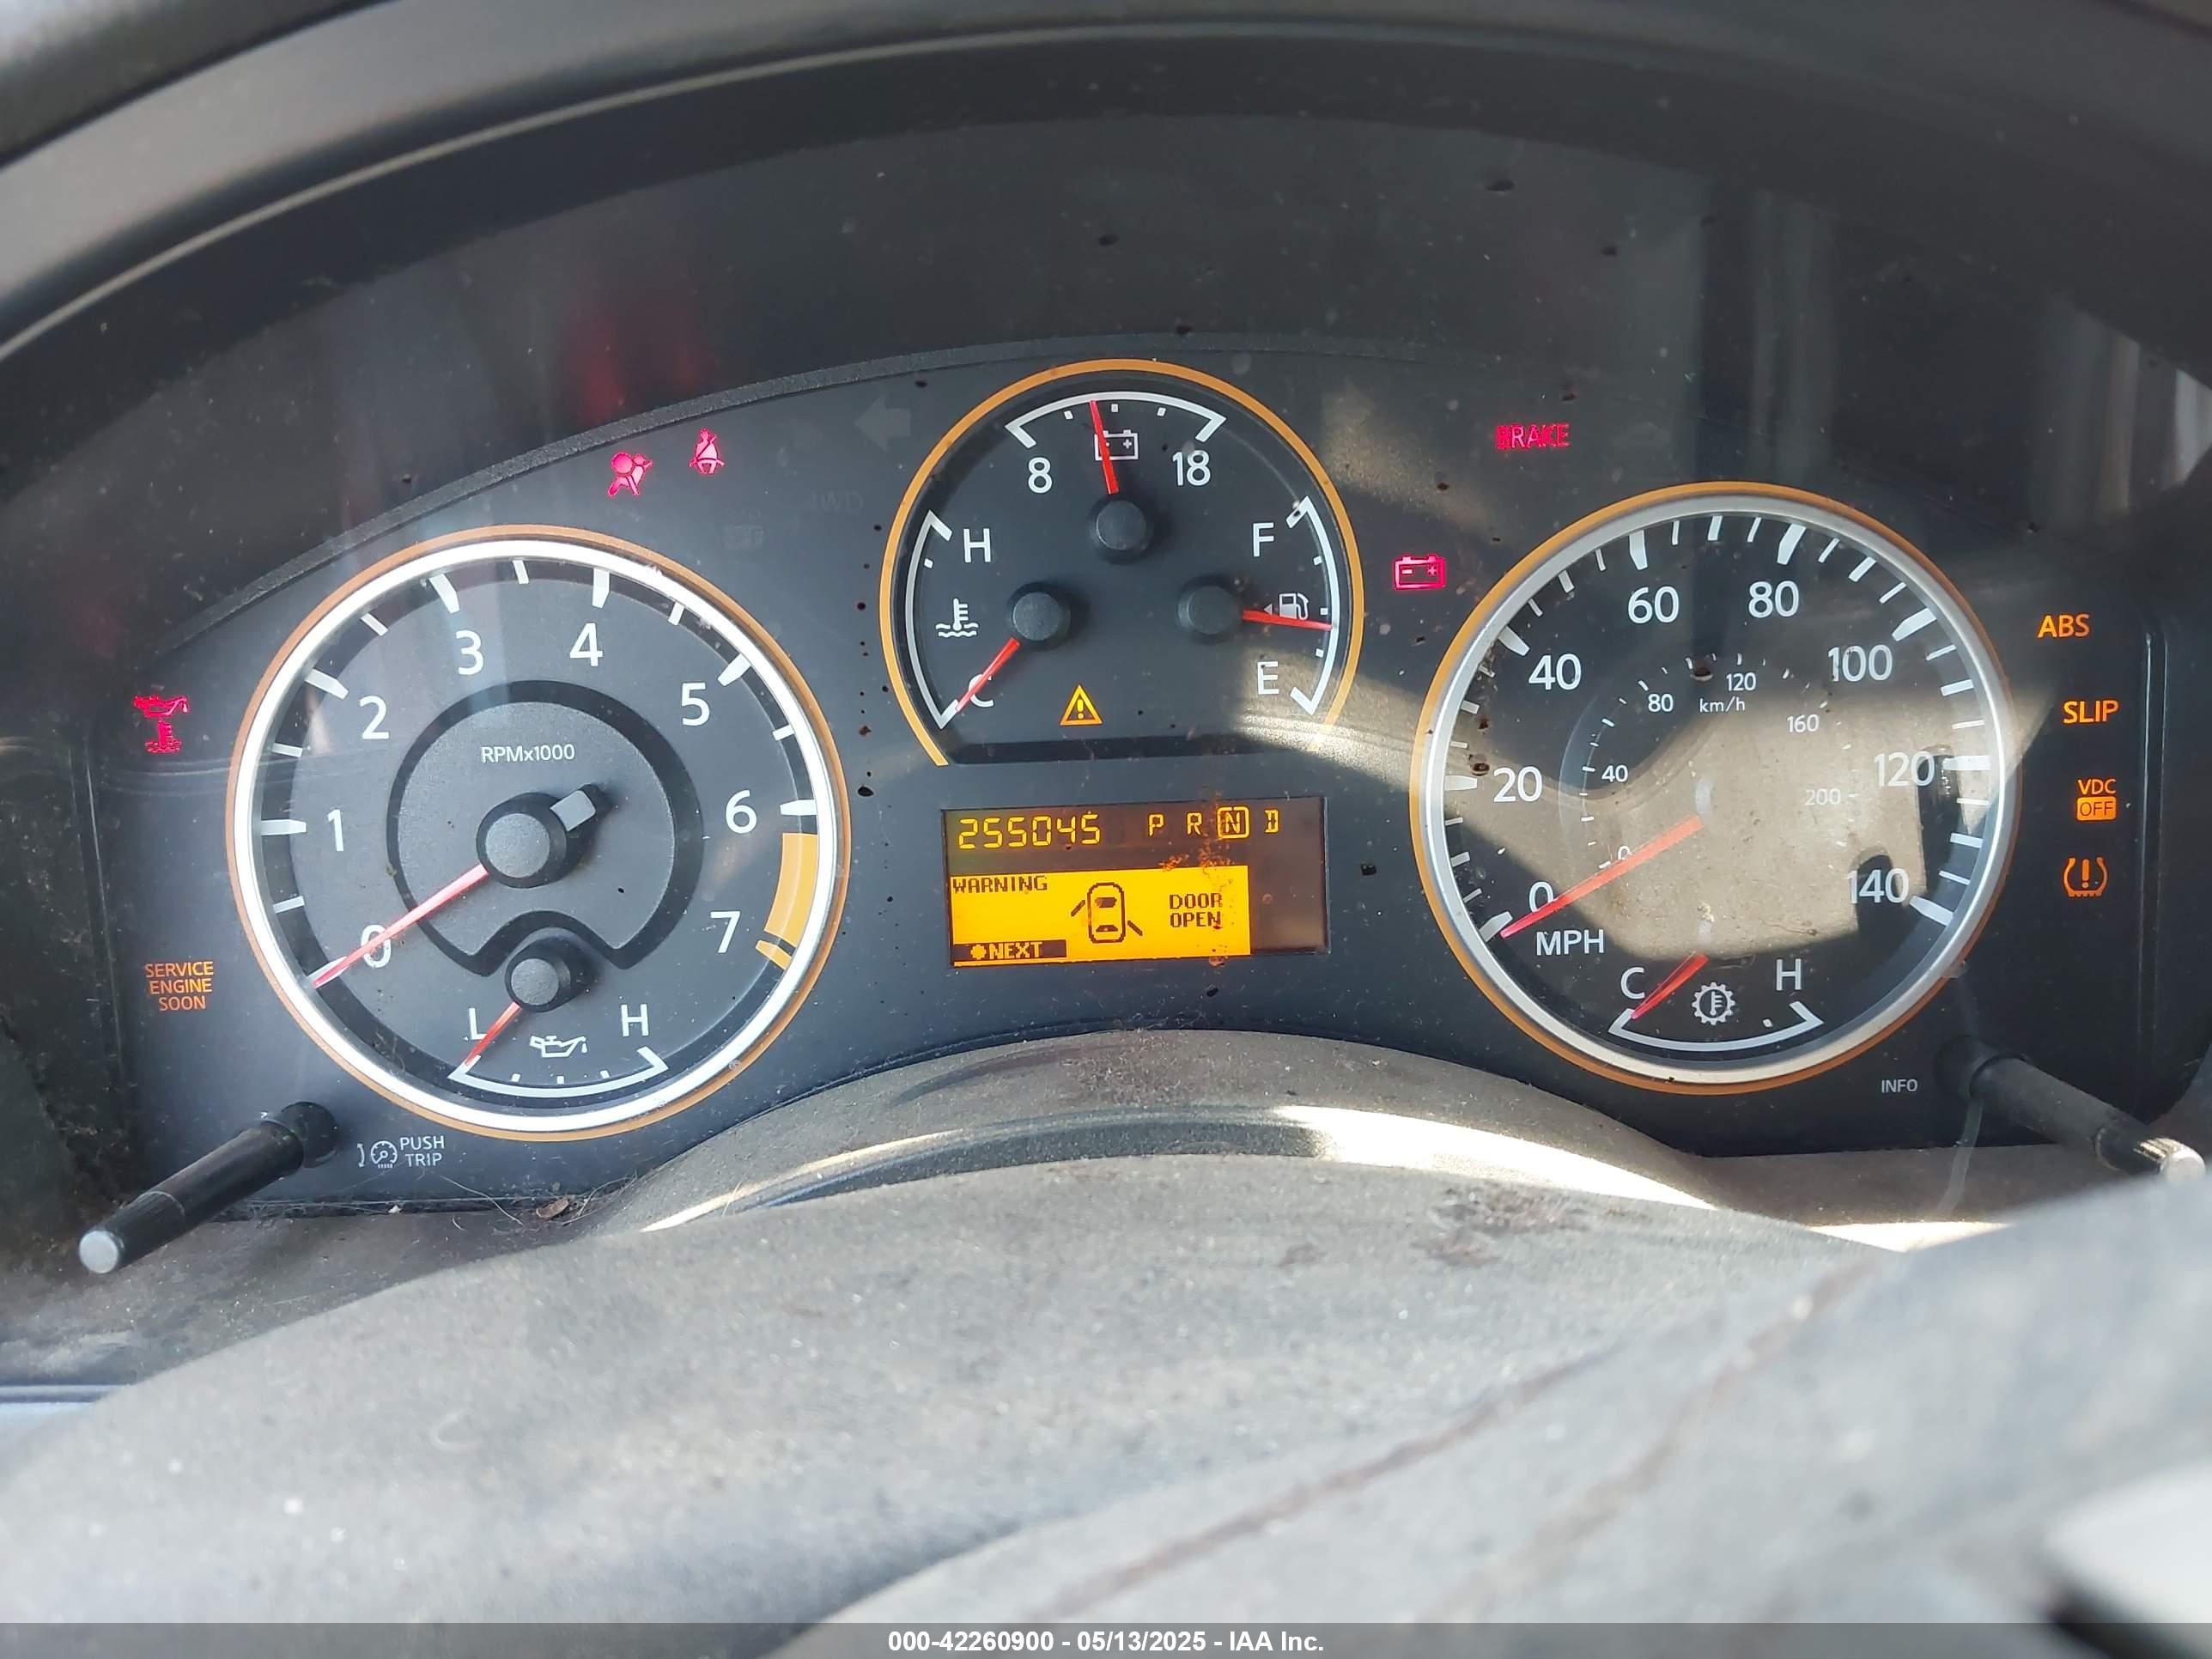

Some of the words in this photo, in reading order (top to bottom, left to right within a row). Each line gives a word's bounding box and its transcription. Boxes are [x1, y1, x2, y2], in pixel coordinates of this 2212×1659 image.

[1028, 458, 1053, 494] 8
[1173, 451, 1211, 487] 18
[963, 528, 991, 562] H
[1253, 522, 1275, 557] F
[1628, 586, 1680, 623] 60
[1748, 580, 1800, 618] 80
[2038, 615, 2090, 638] ABS
[456, 630, 484, 676] 3
[570, 623, 604, 666] 4
[1257, 661, 1279, 695] E
[1528, 654, 1582, 690] 40
[1828, 645, 1893, 683] 100
[968, 673, 994, 708] C
[1726, 672, 1757, 691] 120
[360, 696, 389, 739] 2
[681, 683, 710, 726] 5
[1648, 694, 1674, 713] 80
[1699, 696, 1746, 714] km/h
[2063, 700, 2118, 724] SLIP
[1787, 714, 1820, 733] 160
[481, 744, 575, 763] RPMx1000
[1874, 751, 1936, 787] 120
[1492, 767, 1542, 804] 20
[1601, 764, 1628, 783] 40
[2077, 778, 2117, 795] VDC
[726, 789, 757, 834] 6
[1804, 787, 1842, 806] 200
[2081, 799, 2113, 817] OFF
[326, 809, 344, 852] 1
[957, 811, 1102, 850] 255045
[1148, 813, 1164, 836] P
[1187, 812, 1202, 836] R
[1264, 809, 1279, 833] D
[953, 875, 1048, 894] WARNING
[1169, 893, 1223, 909] DOOR
[1528, 881, 1554, 915] 0
[1847, 868, 1909, 904] 140
[709, 910, 741, 953] 7
[1170, 910, 1222, 928] OPEN
[360, 924, 392, 968] 0
[988, 942, 1043, 960] NEXT
[1535, 928, 1605, 957] MPH
[144, 961, 215, 978] SERVICE
[149, 977, 213, 995] ENGINE
[1620, 967, 1646, 1000] C
[1775, 958, 1802, 991] H
[158, 994, 207, 1012] SOON
[468, 1007, 488, 1042] L
[621, 1004, 649, 1036] H
[1881, 1079, 1918, 1094] INFO
[399, 1134, 445, 1152] PUSH
[404, 1151, 443, 1168] TRIP
